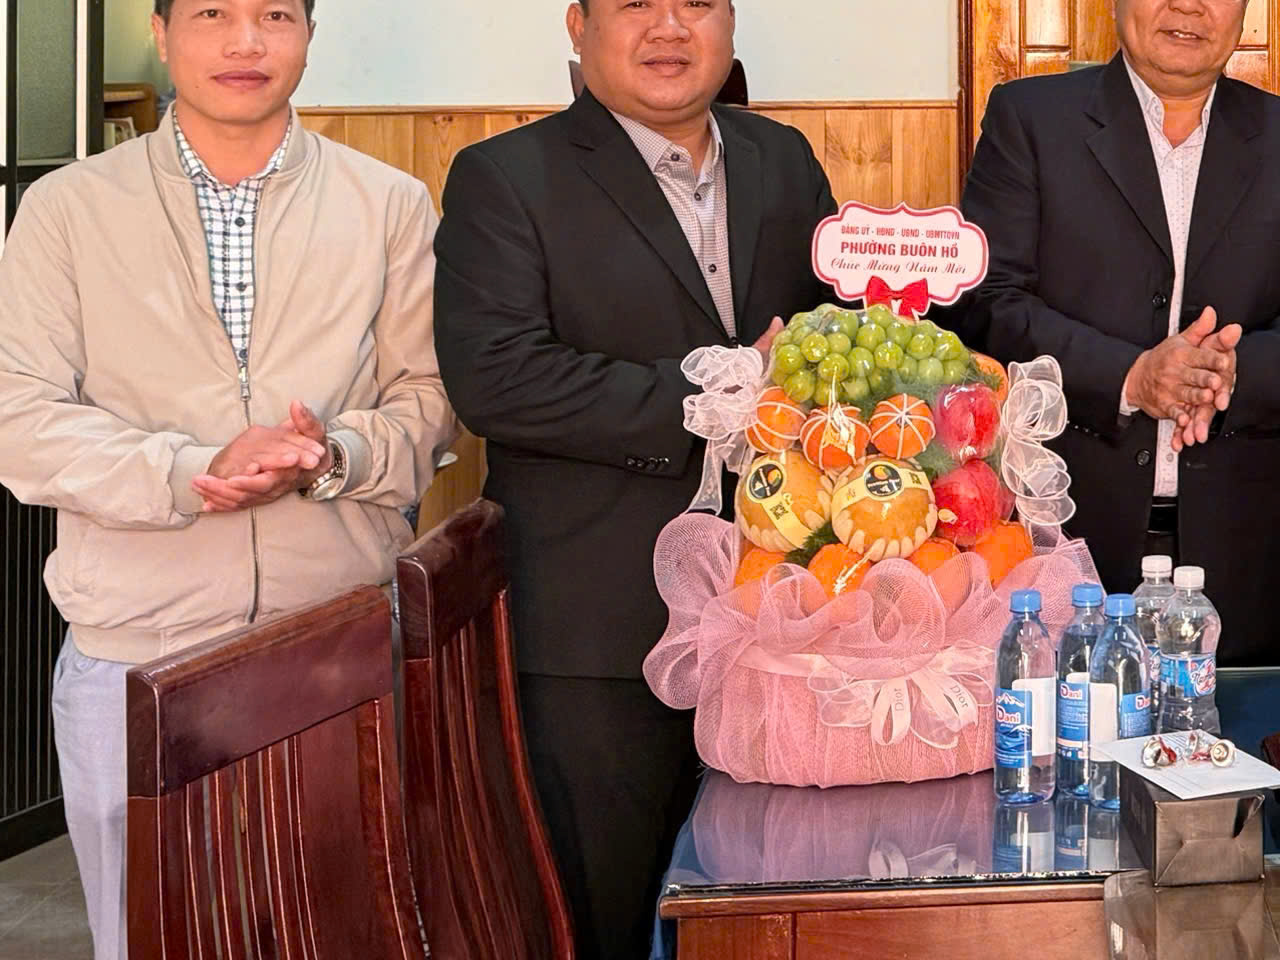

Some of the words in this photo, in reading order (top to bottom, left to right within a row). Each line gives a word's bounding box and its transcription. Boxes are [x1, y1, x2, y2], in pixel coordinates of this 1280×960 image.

[901, 228, 920, 238] UBND
[841, 240, 896, 255] PHƯỜNG
[901, 242, 937, 257] BUÔN
[942, 242, 959, 258] HỒ
[950, 685, 969, 708] Dior
[1061, 685, 1082, 698] Dani
[997, 706, 1020, 722] Dani
